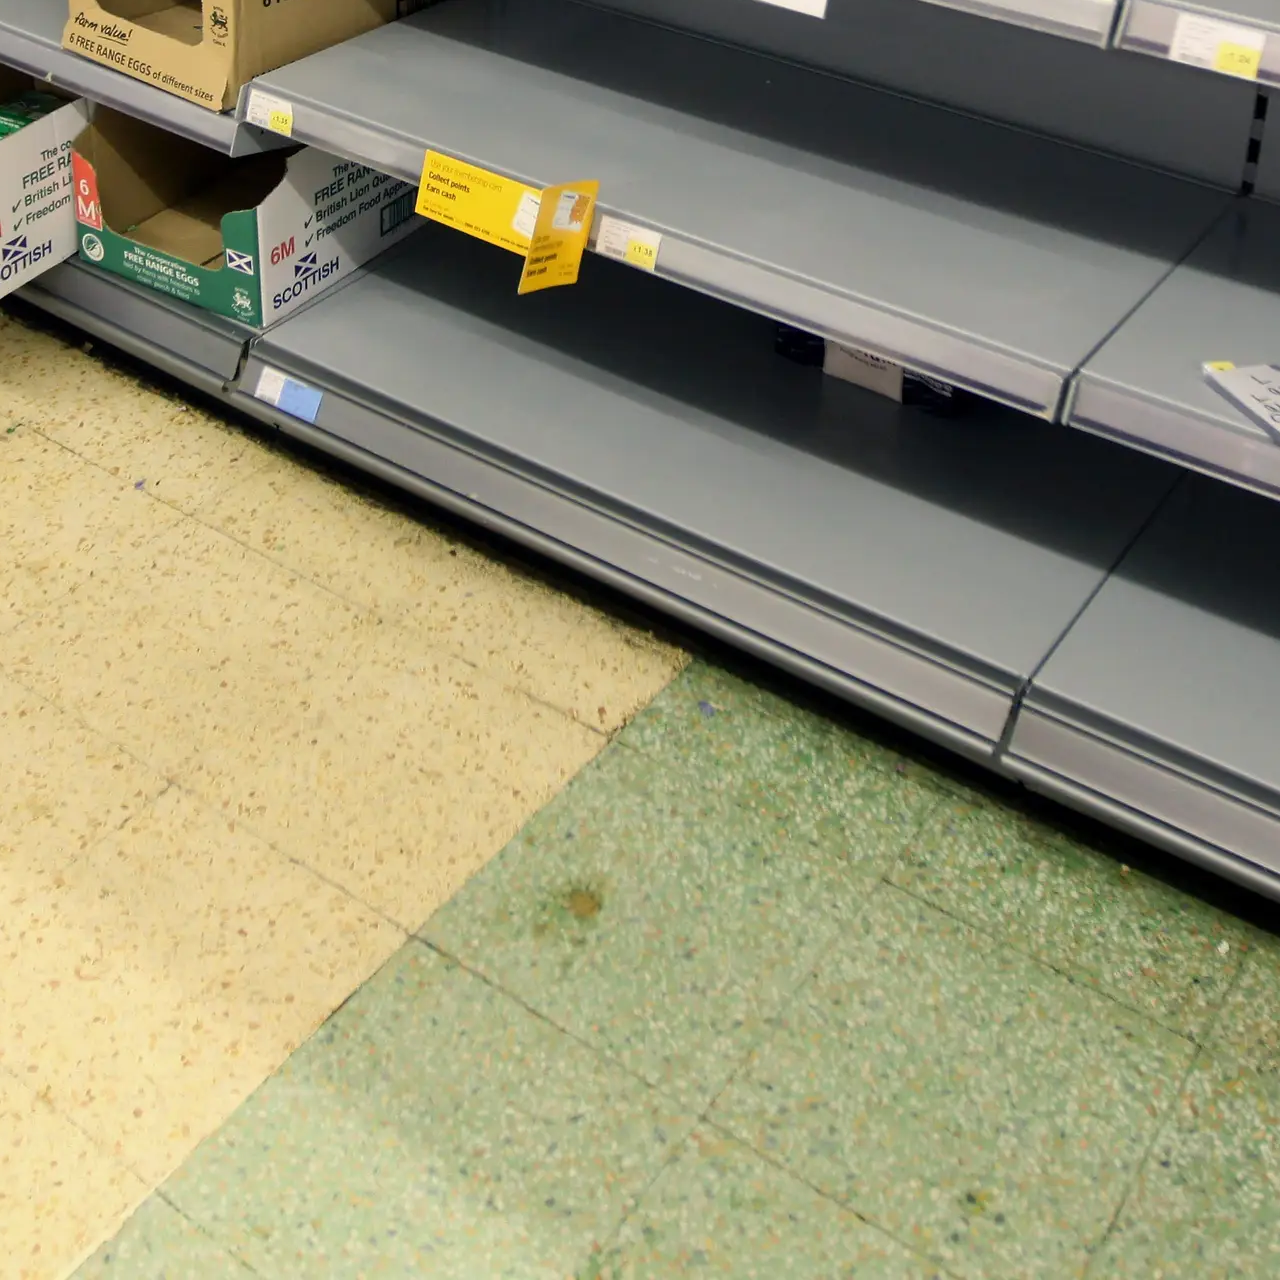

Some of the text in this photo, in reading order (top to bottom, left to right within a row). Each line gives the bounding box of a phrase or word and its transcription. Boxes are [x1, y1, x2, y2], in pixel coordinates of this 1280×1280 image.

[74, 11, 134, 43] farm value!
[69, 32, 215, 103] 6 FREE RANGE EGGS of different sizes
[40, 146, 59, 163] The
[332, 161, 351, 179] The
[22, 161, 56, 190] FREE
[79, 178, 89, 196] 6
[314, 164, 375, 206] FREE RAN
[426, 182, 457, 201] Earn cash
[428, 170, 471, 194] Collect points
[24, 182, 60, 208] British
[25, 194, 71, 226] Freedom
[316, 184, 371, 224] British Lion
[316, 194, 382, 242] Freedom Food
[270, 235, 296, 267] 6M
[123, 250, 200, 287] FREE RANGE EGGS
[273, 255, 341, 310] SCOTTISH
